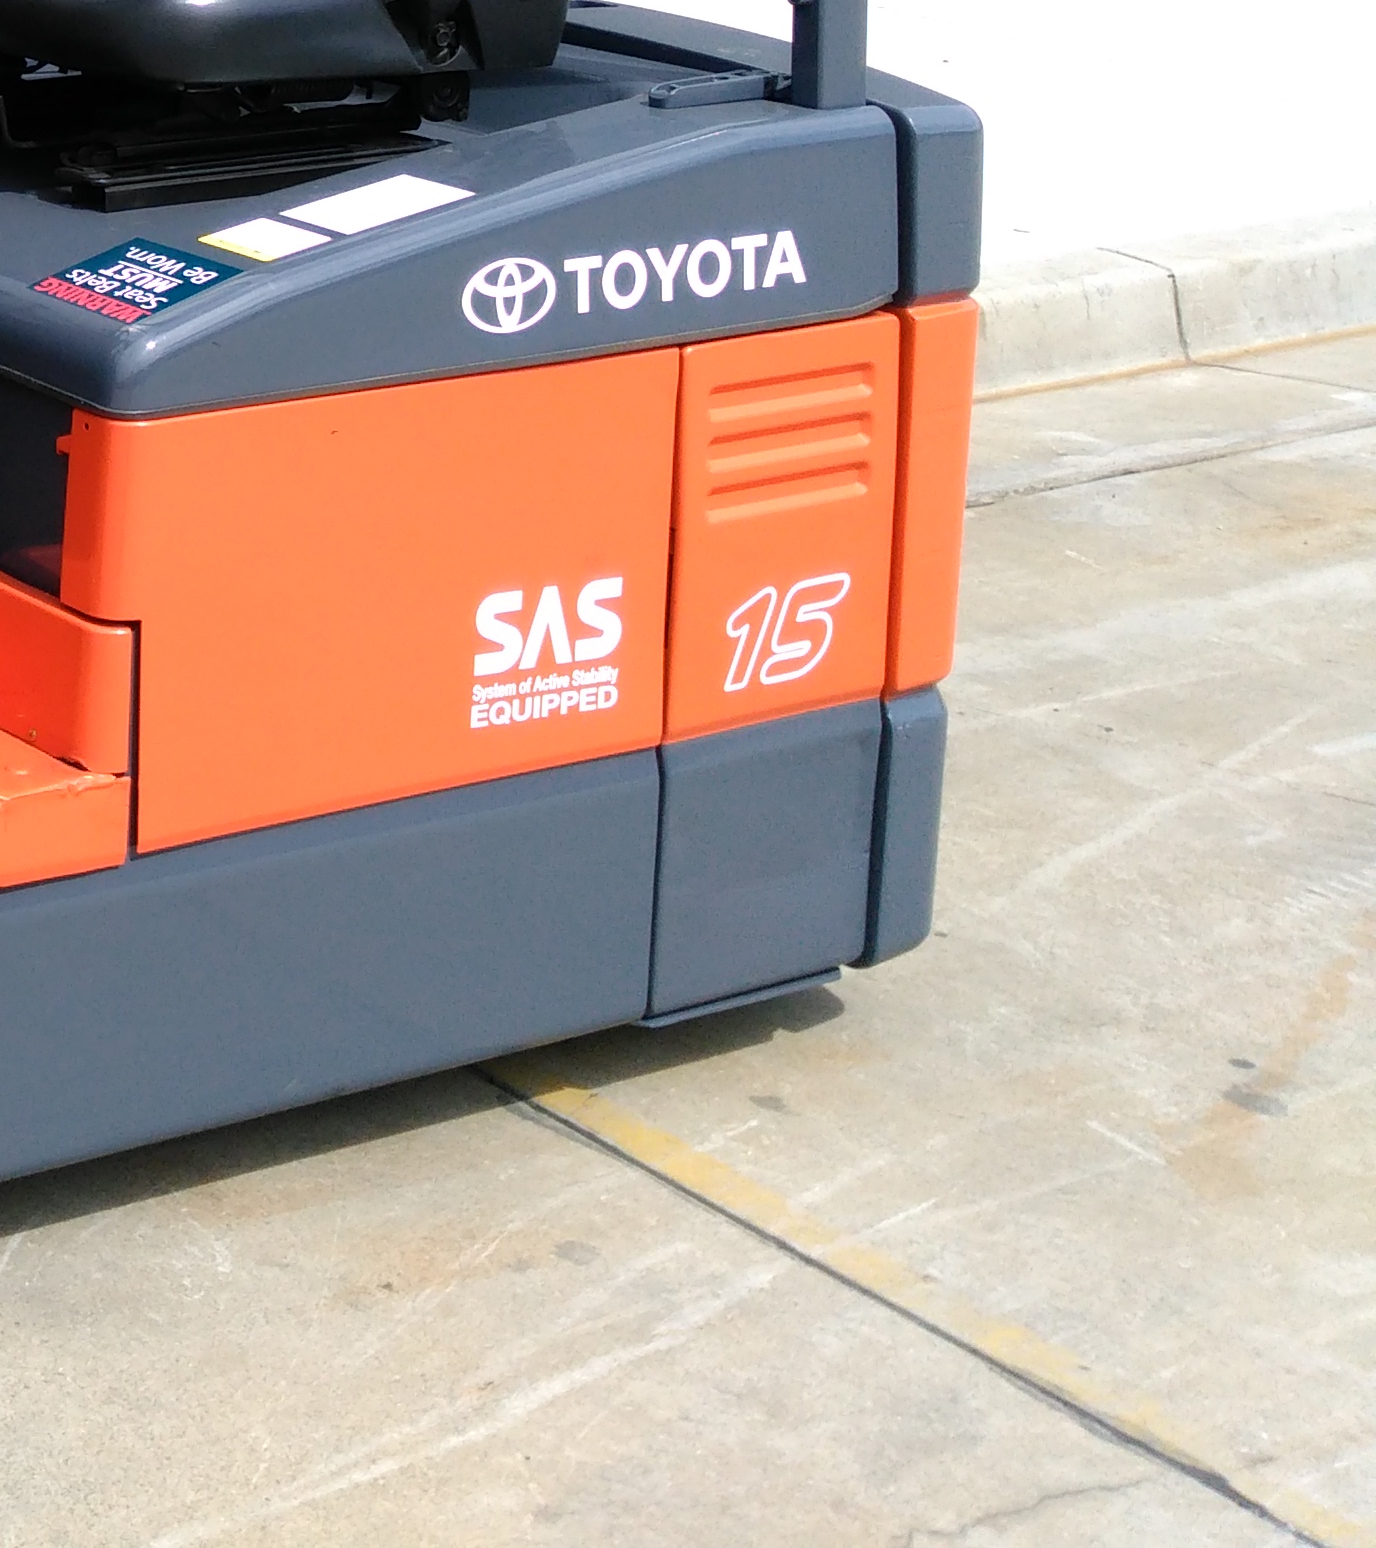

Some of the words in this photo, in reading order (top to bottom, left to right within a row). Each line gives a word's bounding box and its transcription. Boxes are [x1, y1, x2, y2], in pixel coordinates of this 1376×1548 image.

[98, 265, 178, 293] MUST
[124, 246, 185, 275] Worn.
[182, 266, 219, 285] Be
[563, 229, 807, 314] TOYOTA
[65, 268, 121, 292] Belts
[114, 286, 168, 310] Seat
[33, 279, 141, 324] WARNING
[472, 576, 624, 676] SAS
[723, 572, 851, 692] 15
[472, 684, 516, 703] System
[519, 676, 532, 694] of
[533, 673, 570, 692] Active
[572, 666, 619, 686] Stability
[470, 685, 618, 728] EQUIPPED
